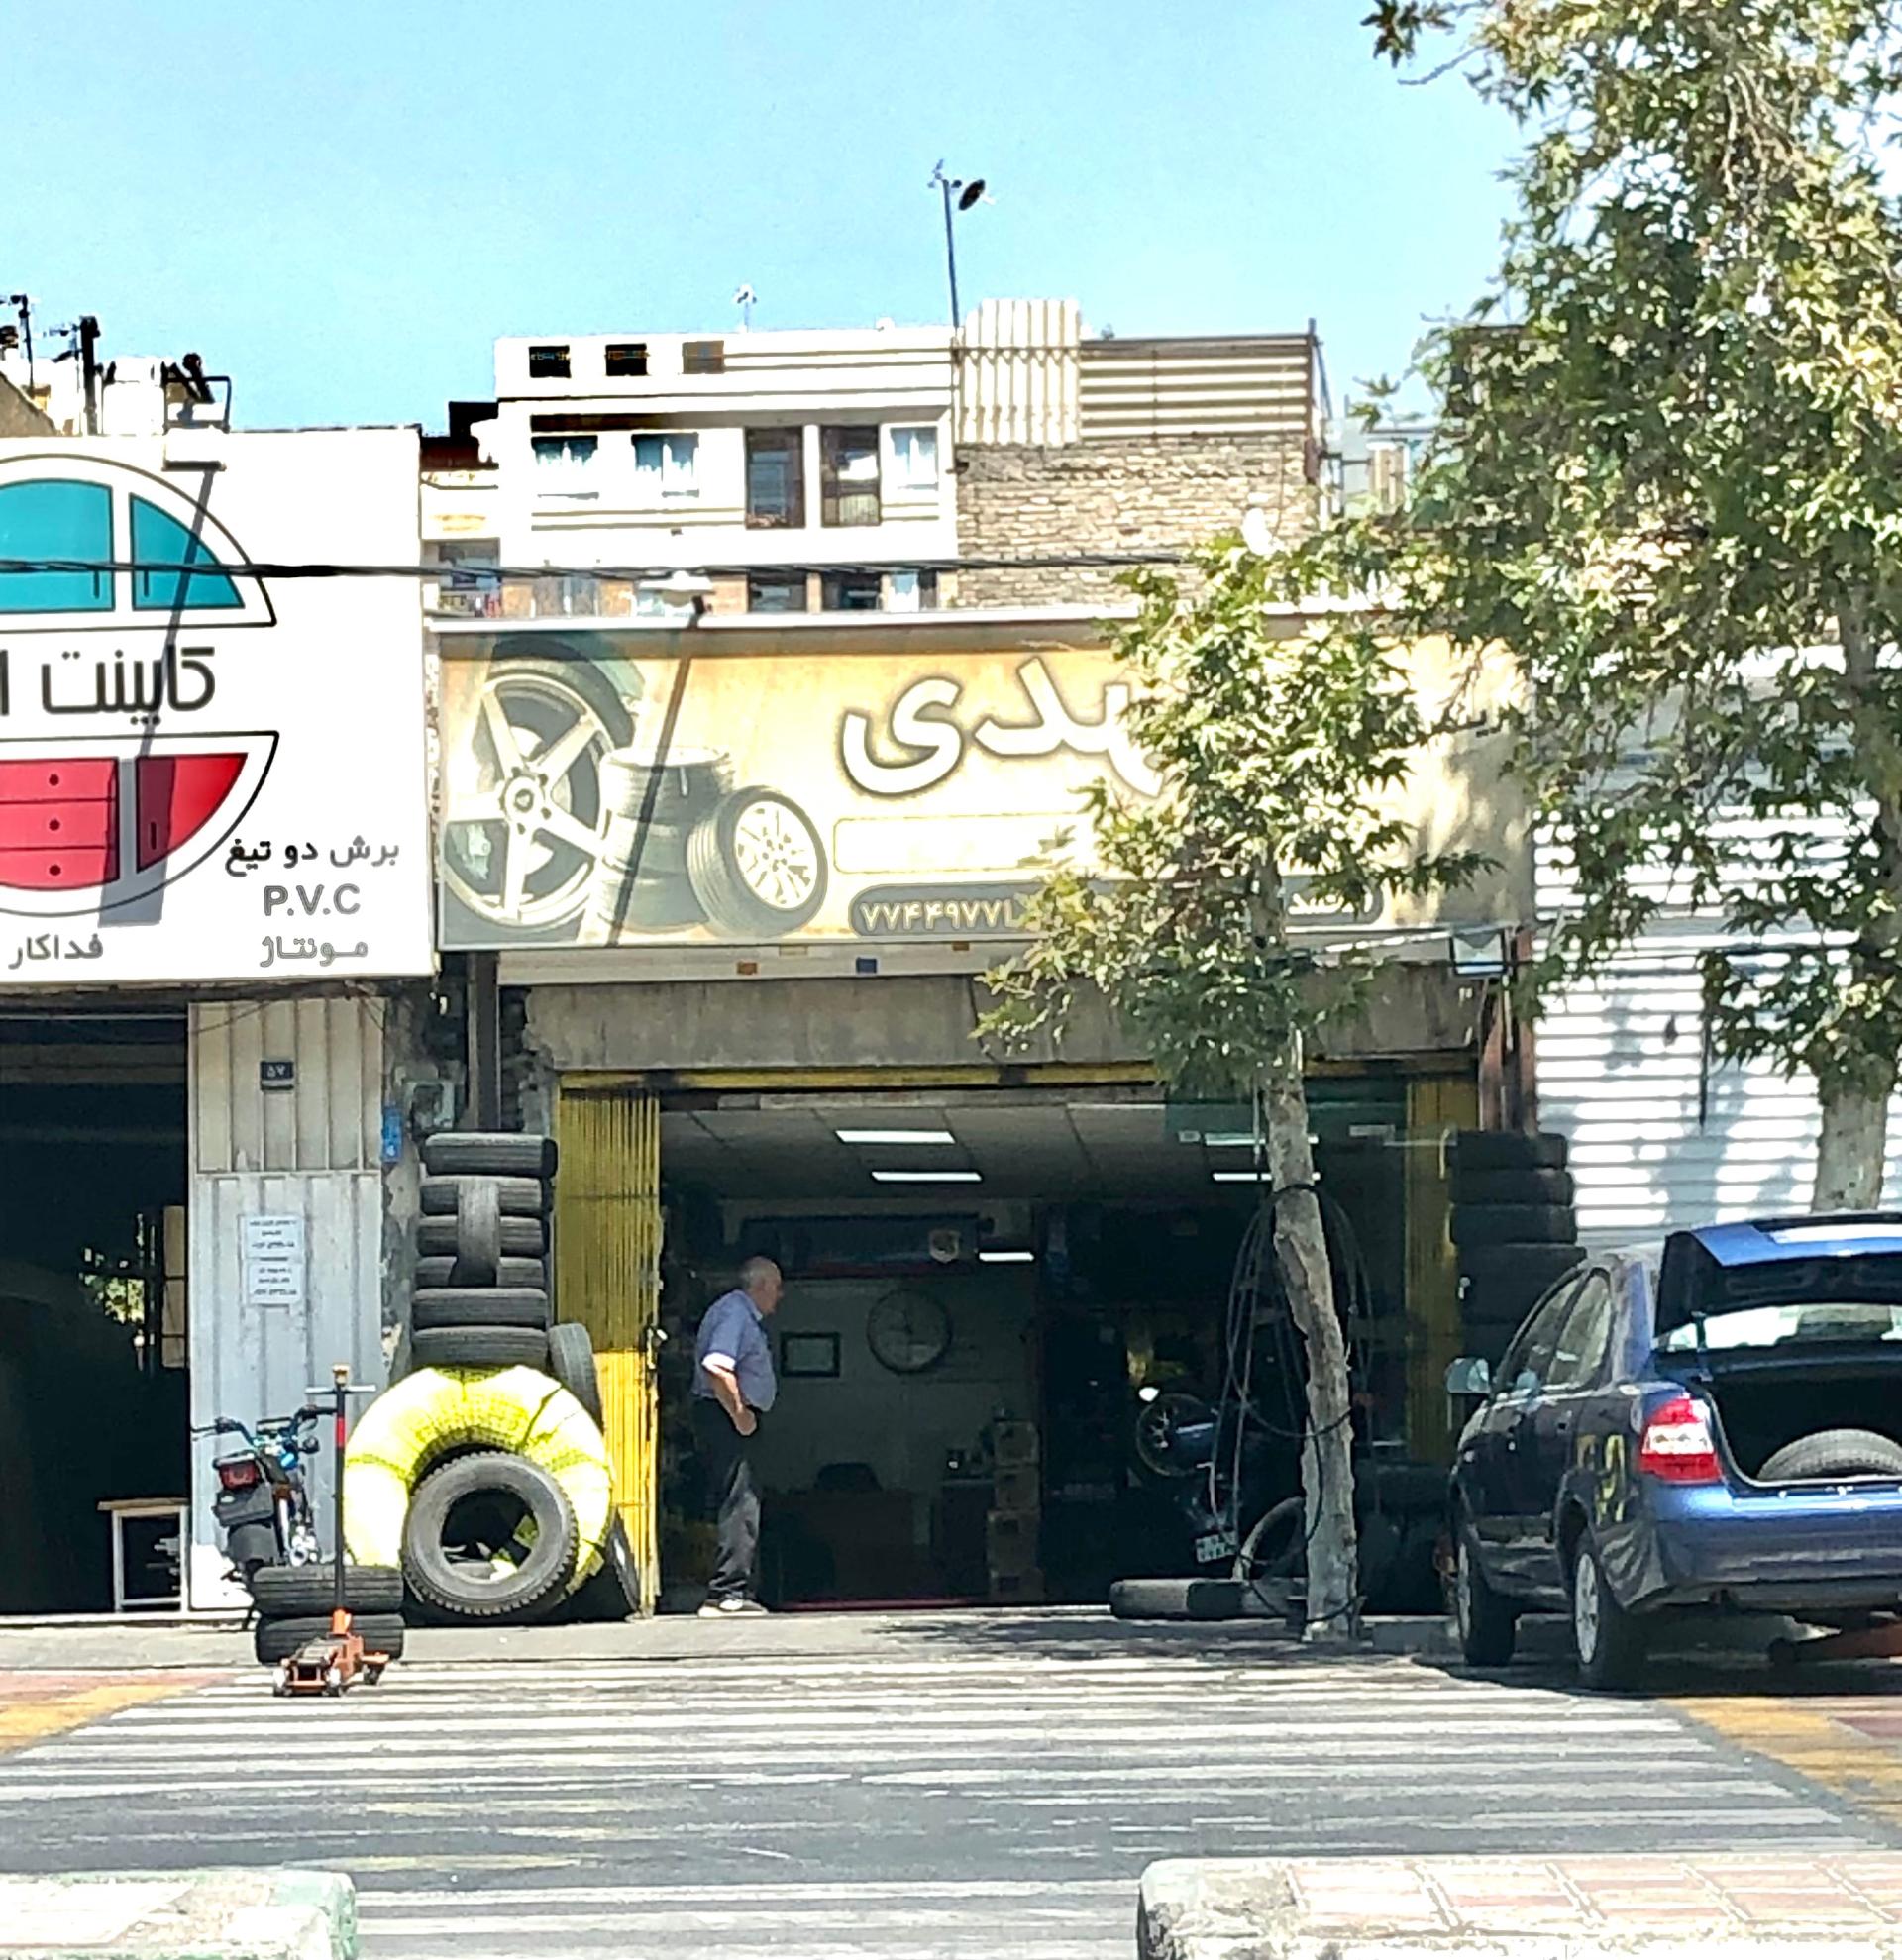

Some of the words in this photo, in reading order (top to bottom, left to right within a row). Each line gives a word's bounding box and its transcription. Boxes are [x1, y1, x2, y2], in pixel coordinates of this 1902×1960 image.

[41, 646, 216, 726] کابینت
[840, 656, 1165, 798] هدی
[224, 838, 272, 878] تیغ
[282, 842, 319, 870] دو
[329, 835, 400, 868] برش
[263, 882, 361, 917] P.V.C
[7, 932, 104, 971] فداکار
[259, 935, 370, 969] مونتاژ
